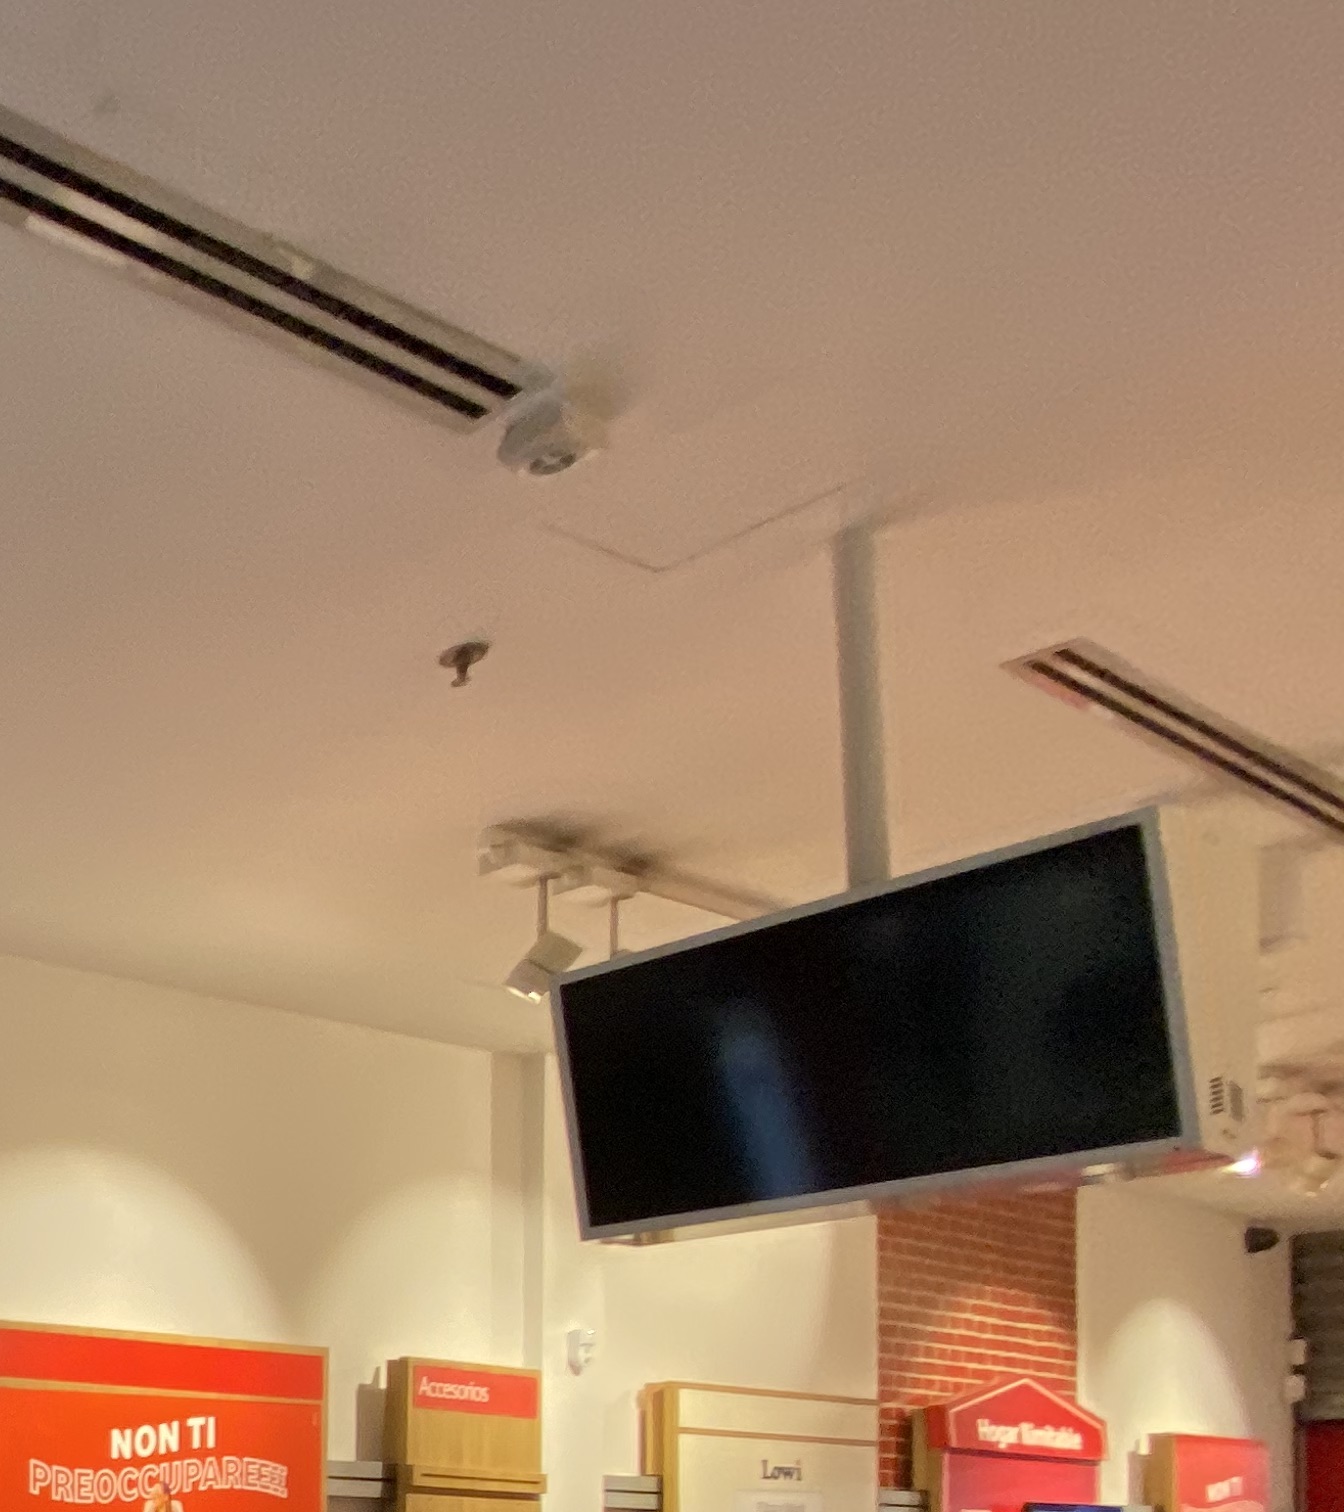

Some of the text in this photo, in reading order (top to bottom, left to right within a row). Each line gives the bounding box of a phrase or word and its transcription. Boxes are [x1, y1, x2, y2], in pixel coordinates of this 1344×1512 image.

[417, 1375, 490, 1403] Accesorios
[110, 1416, 216, 1460] NON TI
[760, 1458, 803, 1482] Lowi
